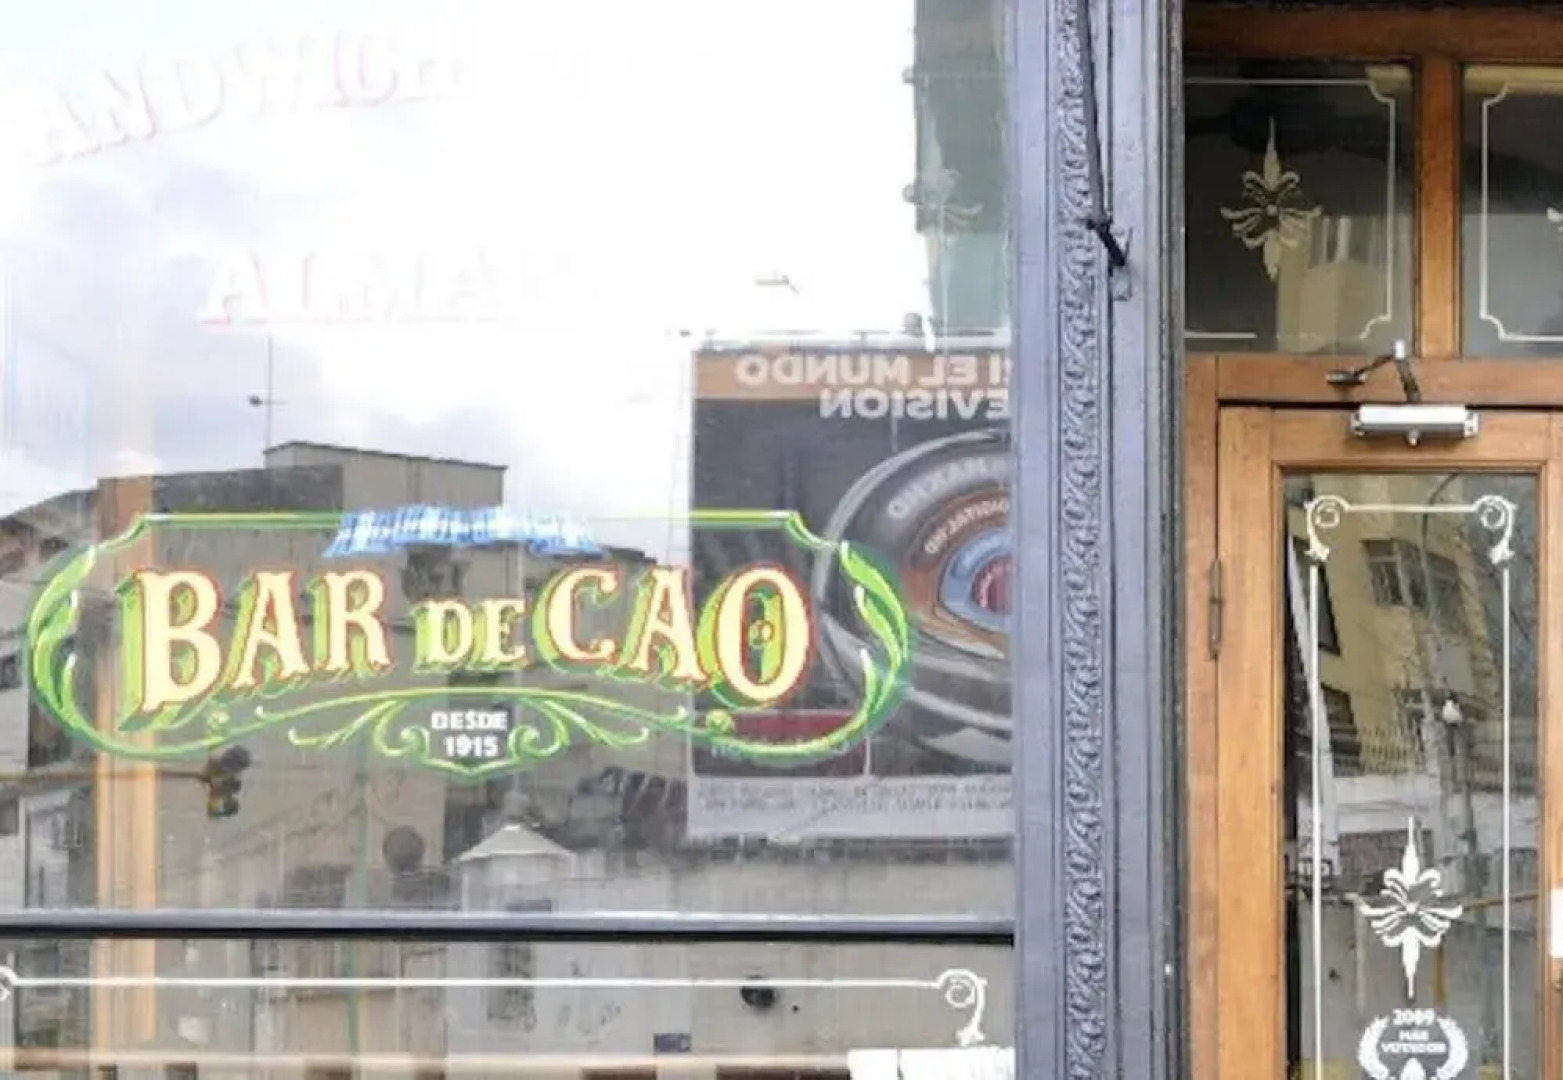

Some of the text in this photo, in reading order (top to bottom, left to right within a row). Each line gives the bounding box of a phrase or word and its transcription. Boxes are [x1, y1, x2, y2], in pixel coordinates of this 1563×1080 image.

[118, 563, 817, 729] BAR DE CAO
[431, 711, 508, 731] DESDE
[443, 735, 498, 758] 1915
[1392, 1007, 1435, 1026] 2009
